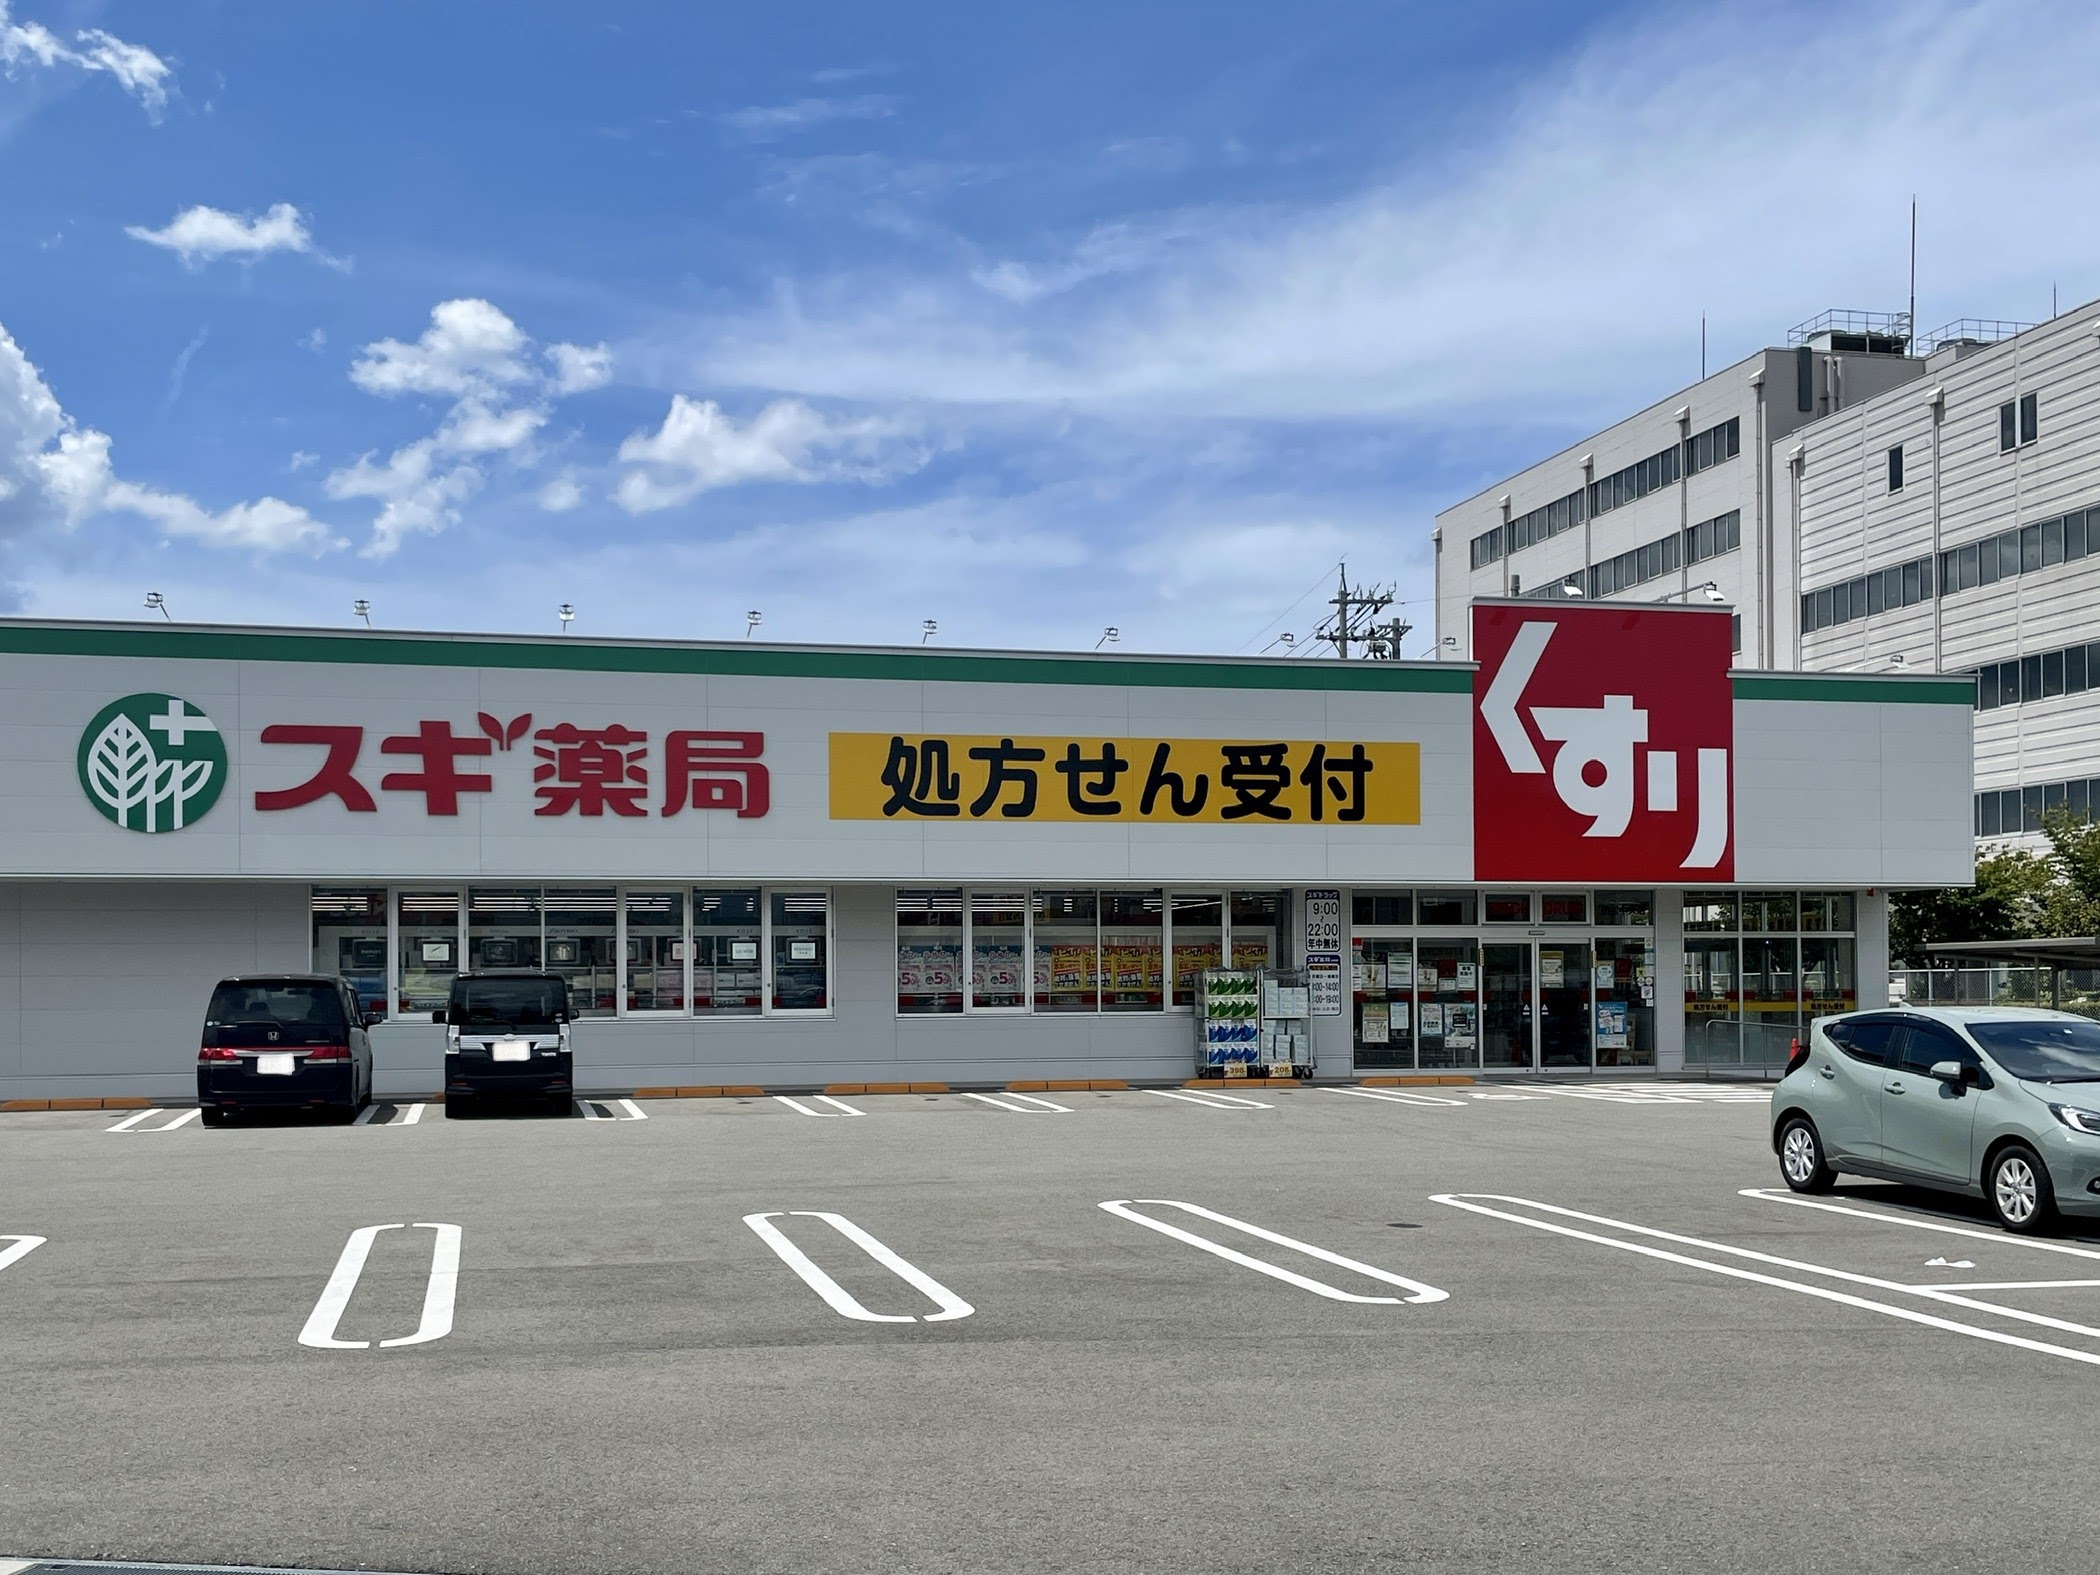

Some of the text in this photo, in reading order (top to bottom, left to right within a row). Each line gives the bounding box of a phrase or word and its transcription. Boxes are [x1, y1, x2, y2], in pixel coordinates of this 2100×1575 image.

[1480, 620, 1729, 869] くすり
[254, 711, 771, 819] スギ薬局
[880, 736, 1374, 822] 処方せん受付
[1306, 891, 1339, 899] スギドラッグ
[1313, 902, 1338, 915] 9:00
[1307, 923, 1338, 936] 22:00
[1308, 938, 1339, 949] 年中無休
[1693, 1003, 1729, 1011] 処方せん受付
[1810, 1003, 1846, 1011] 処方せん受付
